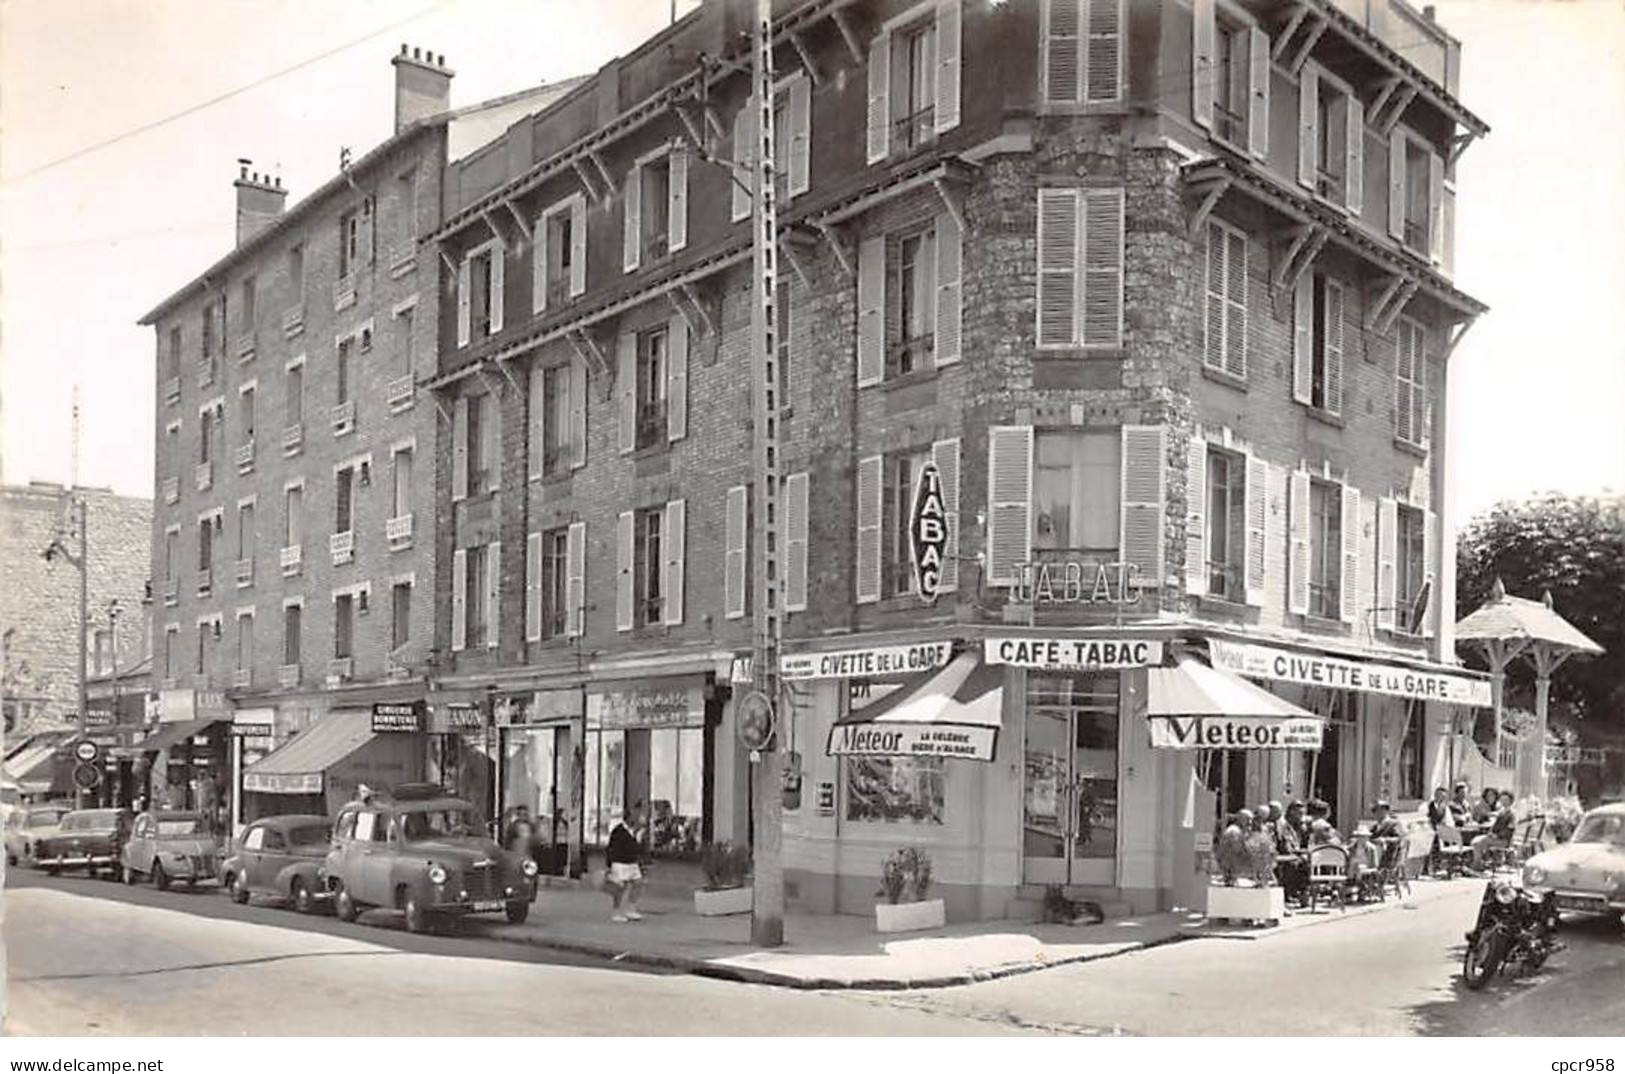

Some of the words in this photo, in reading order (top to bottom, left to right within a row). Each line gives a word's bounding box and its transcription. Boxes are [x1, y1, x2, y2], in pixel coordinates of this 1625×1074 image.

[919, 470, 944, 592] TABAC
[1013, 562, 1141, 604] TABAC
[820, 652, 874, 676] CIVETTE
[876, 654, 890, 671] DE
[893, 653, 904, 670] LA
[1274, 656, 1362, 687] CIVETTE
[1368, 673, 1381, 689] DE
[1387, 677, 1399, 690] LA
[1404, 675, 1448, 698] GARE
[838, 726, 903, 751] Meteor
[1164, 717, 1281, 745] Meteor
